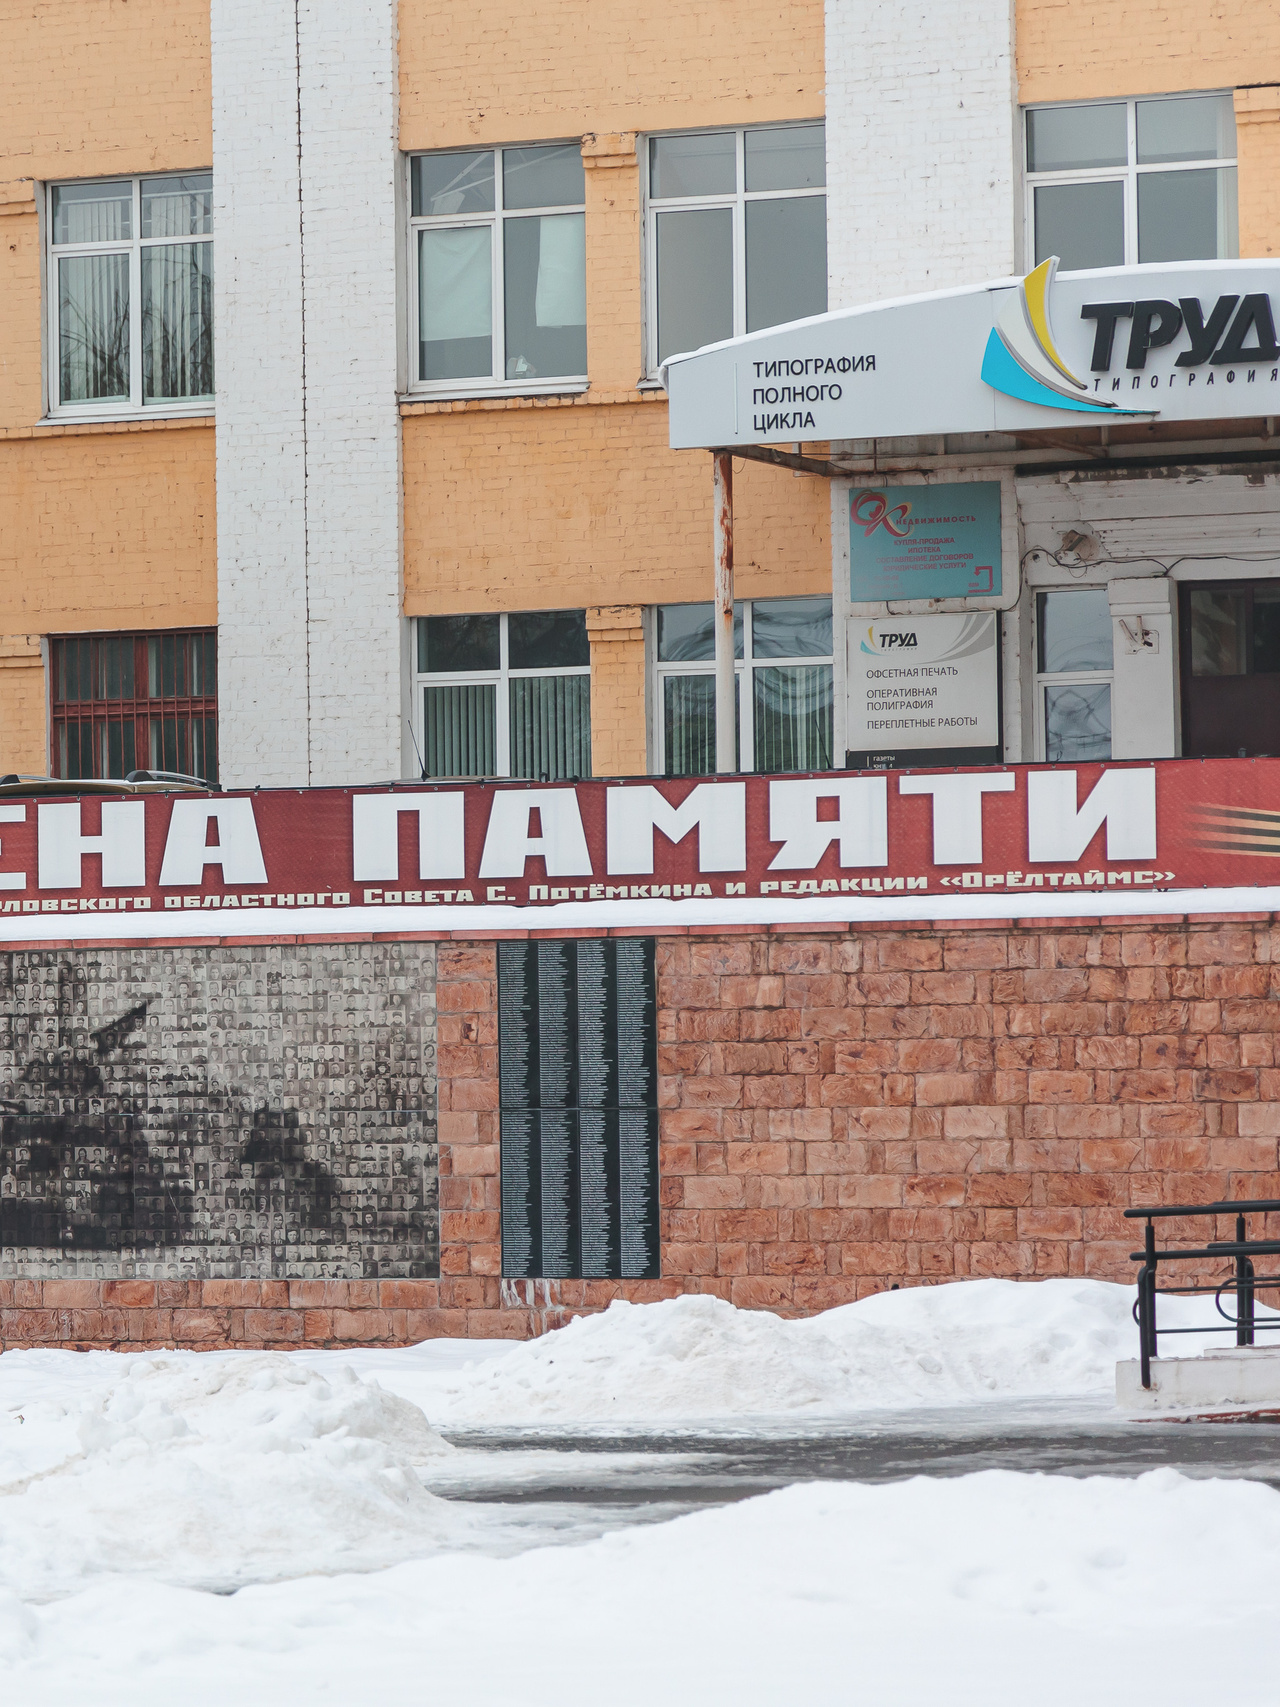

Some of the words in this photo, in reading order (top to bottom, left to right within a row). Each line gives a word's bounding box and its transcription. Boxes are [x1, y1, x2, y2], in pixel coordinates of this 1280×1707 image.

[1080, 292, 1280, 372] ТРУД
[753, 354, 877, 378] ТИПОГРАФИЯ
[1094, 367, 1279, 392] ТИПОГРАФИЯ
[753, 383, 843, 405] ПОЛНОГО
[753, 411, 816, 434] ЦИКЛА
[895, 515, 976, 526] НЕДВИЖИМОСТЬ
[893, 537, 955, 546] КУПЛЯ-ПРОДАЖА
[907, 546, 942, 554] ИПОТЕКА
[928, 553, 974, 562] ДОГОВОРОВ
[939, 562, 967, 570] УСЛУГИ
[879, 632, 918, 648] ТРУД
[866, 668, 919, 679] ОФСЕТНАЯ
[921, 666, 959, 677] ПЕЧАТЬ
[866, 687, 938, 699] ОПЕРАТИВНАЯ
[866, 700, 934, 711] ПОЛИГРАФИЯ
[867, 718, 936, 729] ПЕРЕПЛЕТНЫЕ
[938, 716, 978, 727] РАБОТЫ
[353, 768, 1157, 881] ПАМЯТИ
[486, 886, 516, 901] С.
